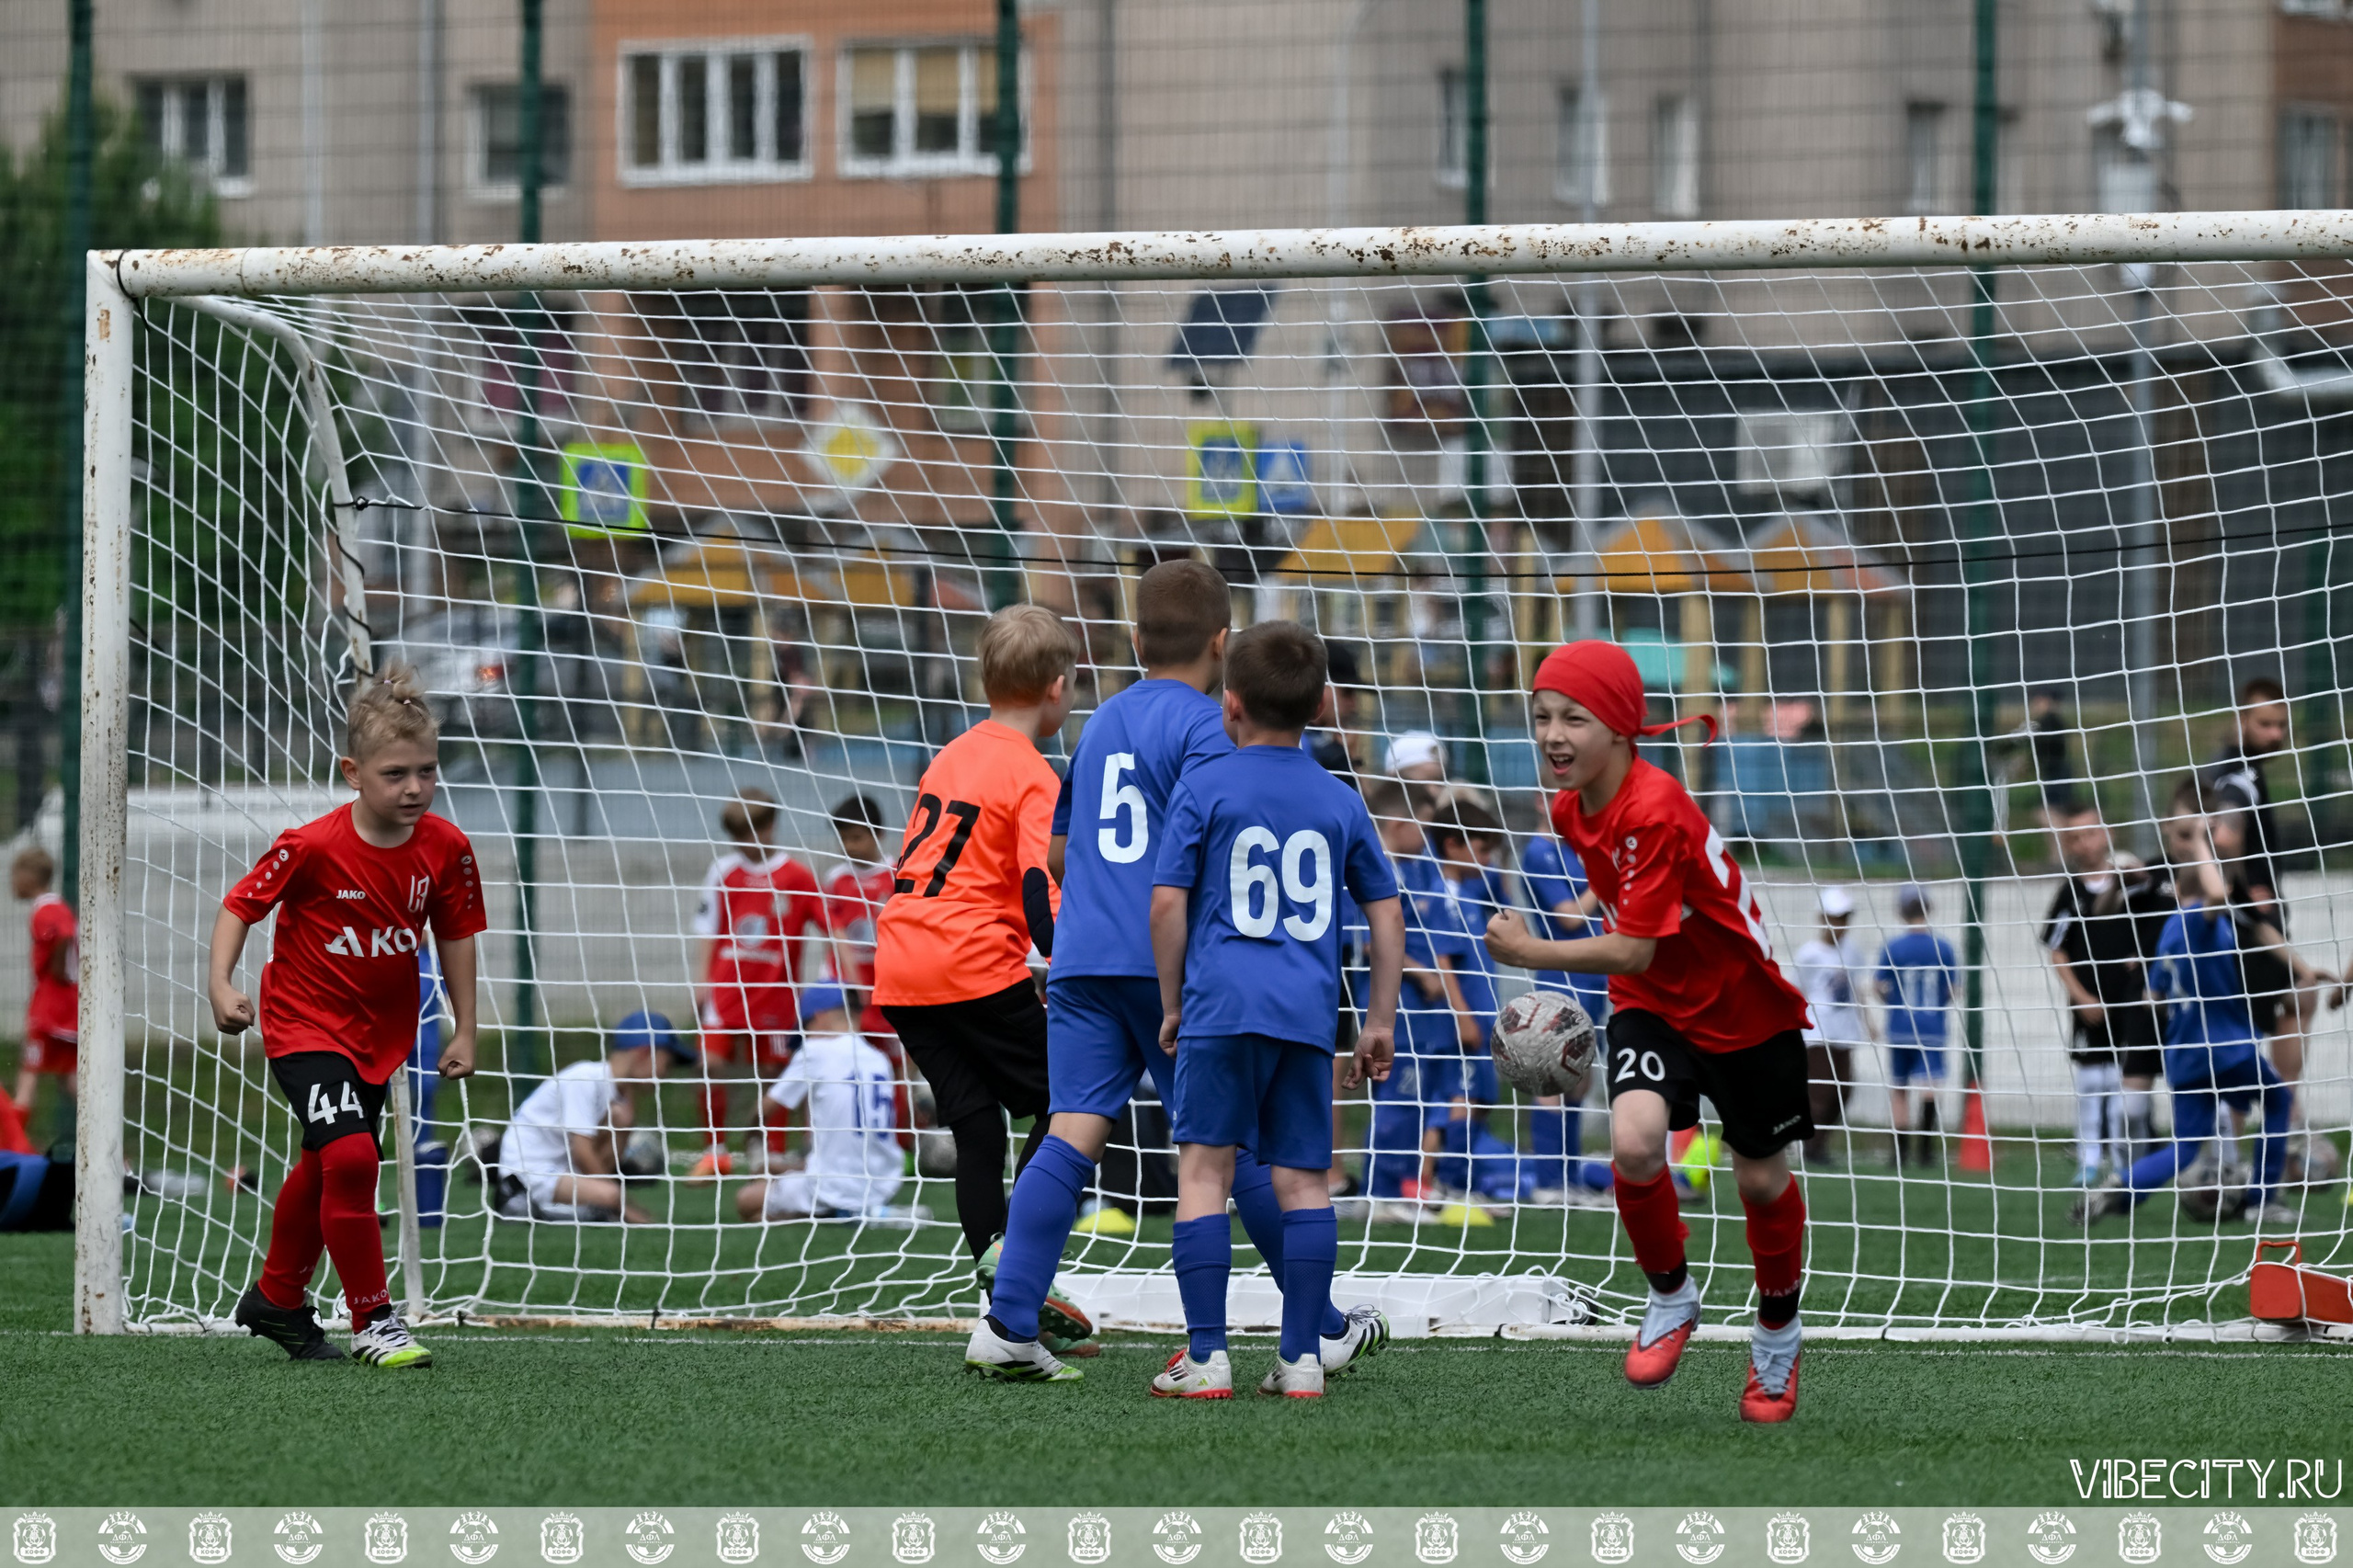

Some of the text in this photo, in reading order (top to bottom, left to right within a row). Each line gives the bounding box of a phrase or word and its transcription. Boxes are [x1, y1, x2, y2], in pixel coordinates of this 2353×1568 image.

[1097, 752, 1149, 864] 5
[893, 792, 982, 897] 27
[335, 889, 367, 901] JAKO
[1230, 825, 1333, 942] 69
[1615, 1047, 1665, 1084] 20
[308, 1080, 365, 1125] 44
[843, 1071, 895, 1140] 15
[353, 1289, 389, 1305] JAKO
